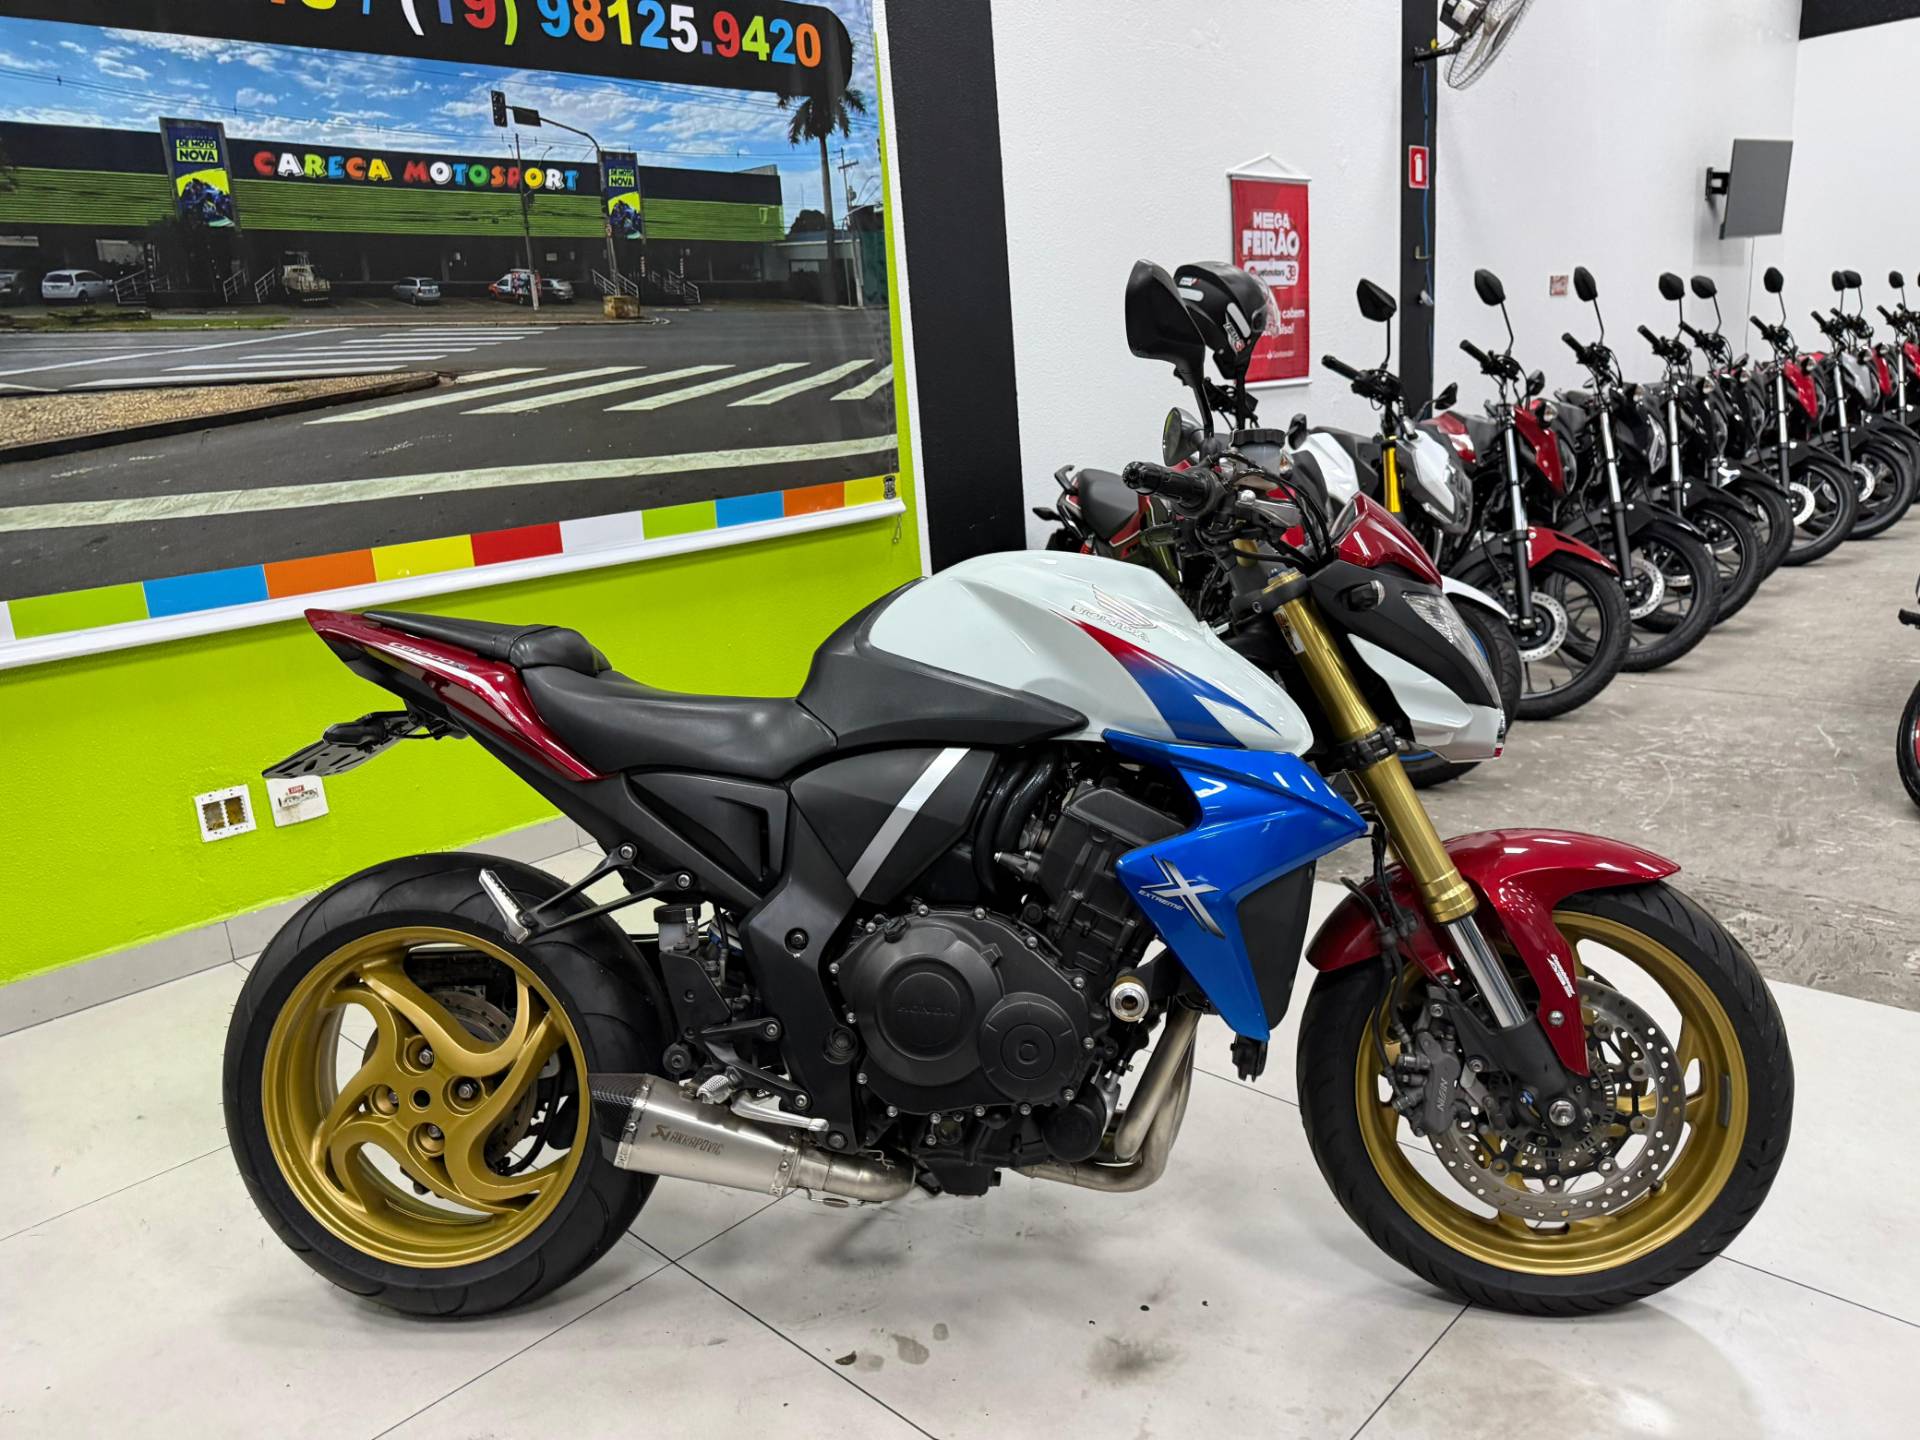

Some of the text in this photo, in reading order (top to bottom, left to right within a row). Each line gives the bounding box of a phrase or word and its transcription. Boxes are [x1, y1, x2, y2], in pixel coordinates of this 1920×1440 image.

[179, 150, 216, 161] NOVA
[253, 151, 579, 191] CARECA MOTOSPORT
[611, 177, 632, 185] NOVA
[1252, 211, 1290, 230] MEGA
[1242, 227, 1300, 257] FEIRÃO
[1138, 889, 1184, 911] EXTREME
